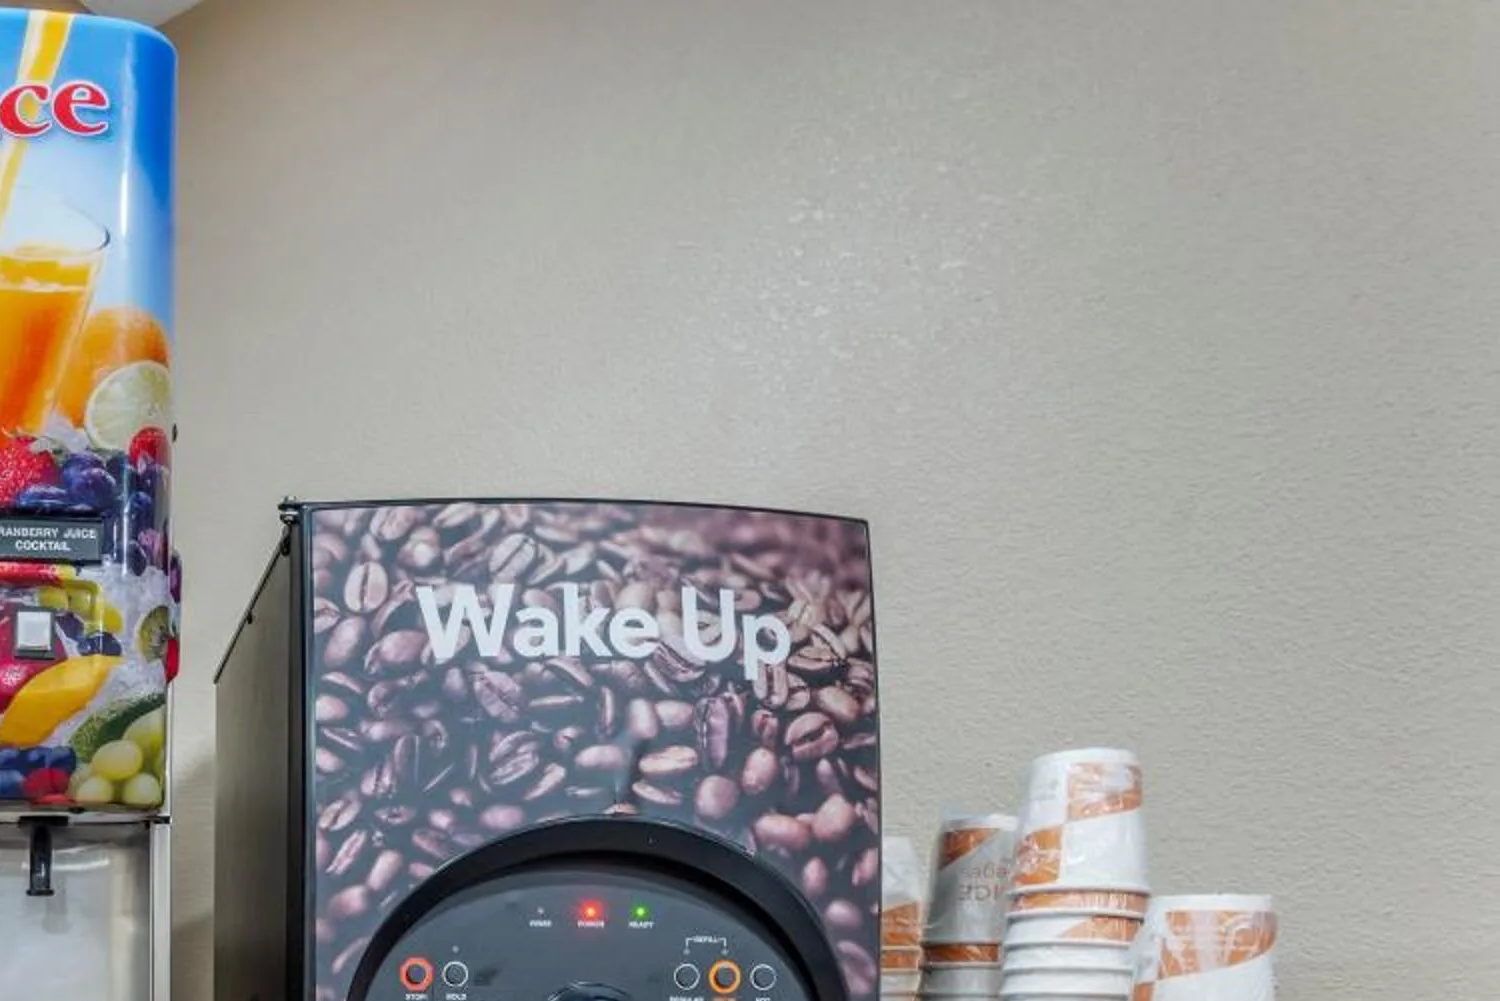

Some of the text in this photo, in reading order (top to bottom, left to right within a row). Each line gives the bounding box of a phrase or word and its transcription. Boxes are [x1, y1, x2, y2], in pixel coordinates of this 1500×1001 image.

[63, 528, 97, 539] JUICE
[15, 540, 71, 552] COCKTAIL
[416, 583, 791, 681] Wake Up
